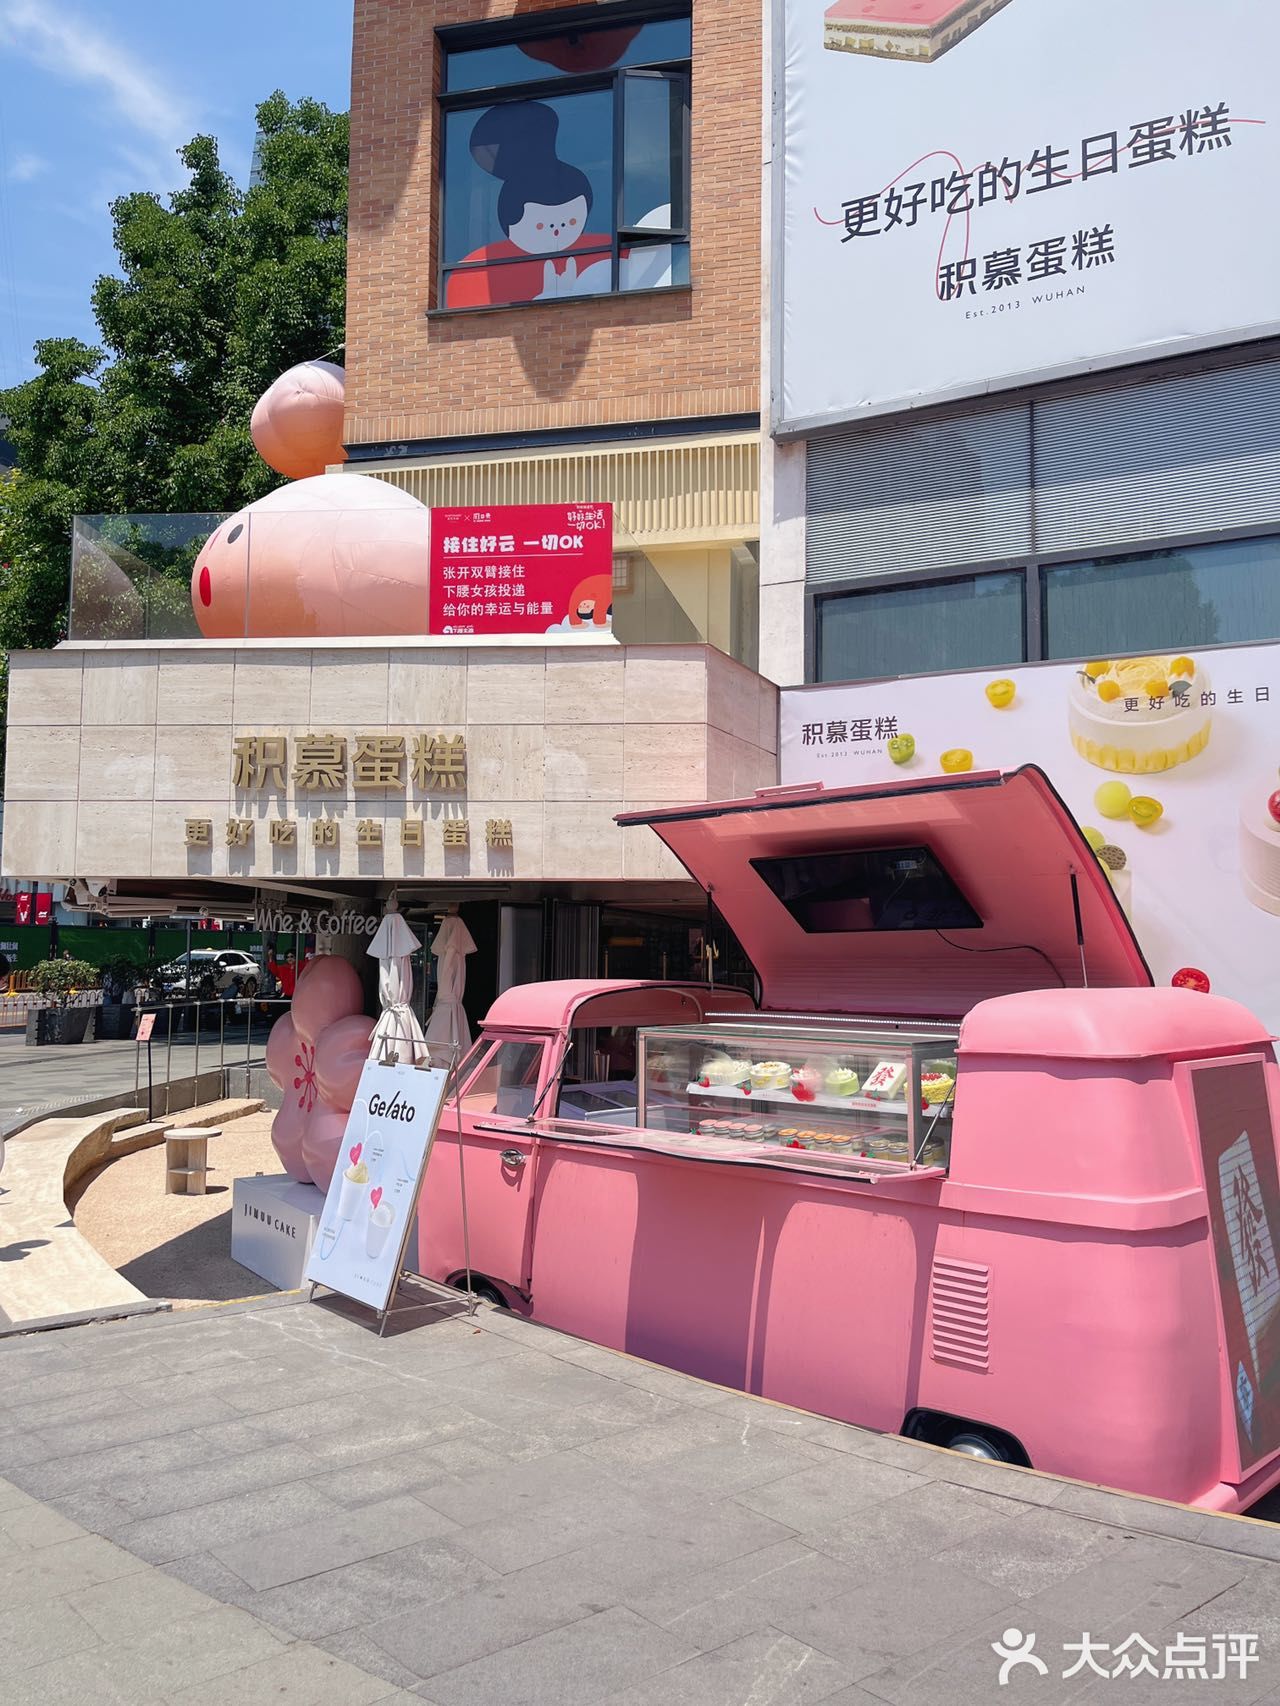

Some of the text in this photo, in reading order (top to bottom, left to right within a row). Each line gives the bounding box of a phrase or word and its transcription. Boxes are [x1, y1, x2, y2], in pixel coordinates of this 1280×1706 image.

[840, 102, 1232, 243] 更好吃的生日蛋糕
[938, 223, 1116, 301] 积慕蛋糕
[965, 286, 1086, 319] Est.2013 WUHAN
[443, 534, 584, 553] 接住好云 一切OK
[443, 564, 525, 579] 张开双臂接住
[443, 584, 525, 598] 下腰女孩投递
[443, 601, 553, 616] 给你的幸运与能量
[1124, 687, 1270, 712] 更好吃的生日
[802, 716, 898, 746] 积慕蛋糕
[232, 733, 466, 790] 积慕蛋糕
[184, 818, 514, 847] 更好吃的生日蛋糕
[298, 909, 312, 933] &
[316, 909, 378, 936] Coffee
[368, 1090, 416, 1123] Gelato
[274, 1219, 296, 1239] CAKE
